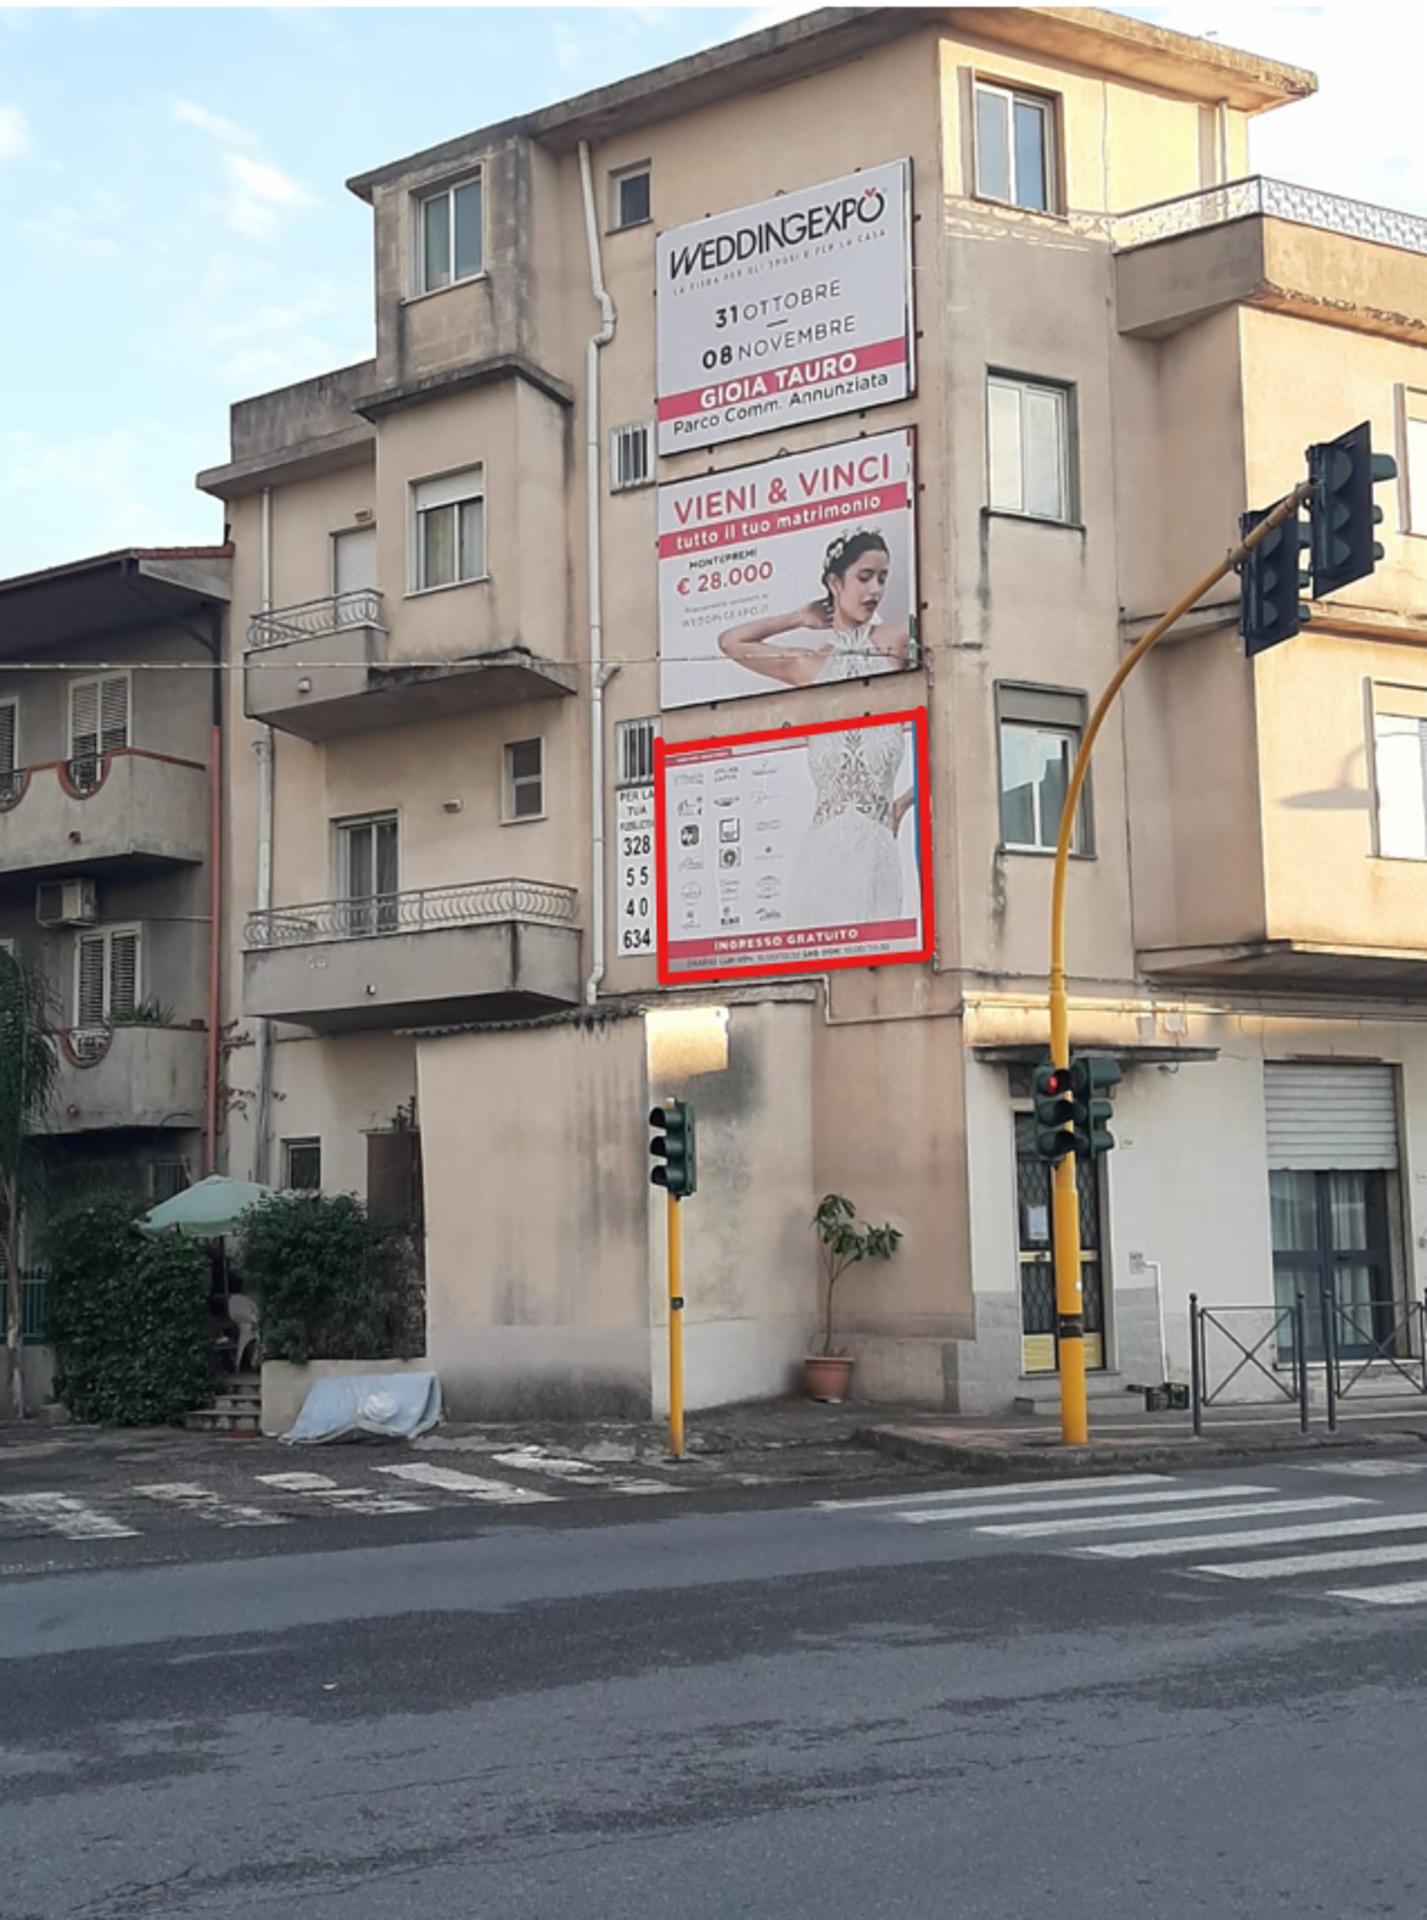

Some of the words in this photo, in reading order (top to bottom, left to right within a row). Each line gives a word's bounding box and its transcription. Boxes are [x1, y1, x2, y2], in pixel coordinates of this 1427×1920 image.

[715, 304, 738, 328] 31
[743, 280, 841, 321] OTTOBRE
[702, 345, 733, 370] 08
[738, 315, 855, 360] NOVEMBRE
[700, 376, 768, 409] GIOIA
[774, 353, 857, 390] TAURO
[673, 415, 720, 436] Parco
[725, 400, 782, 423] Comm.
[790, 373, 889, 406] Annunziata
[674, 484, 756, 525] VIENI
[768, 478, 787, 504] &
[799, 453, 889, 497] VINCI
[676, 533, 719, 550] tutto
[725, 524, 735, 539] il
[742, 521, 771, 537] tuo
[777, 496, 881, 528] matrimonio
[689, 548, 757, 570] MONTEPREMI
[677, 577, 690, 596] €
[698, 561, 773, 592] 28.000
[621, 790, 639, 802] PER
[627, 805, 647, 816] TUA
[624, 835, 651, 857] 328
[623, 928, 651, 949] 634
[713, 935, 783, 951] INGRESSO
[786, 928, 859, 946] GRATUITO
